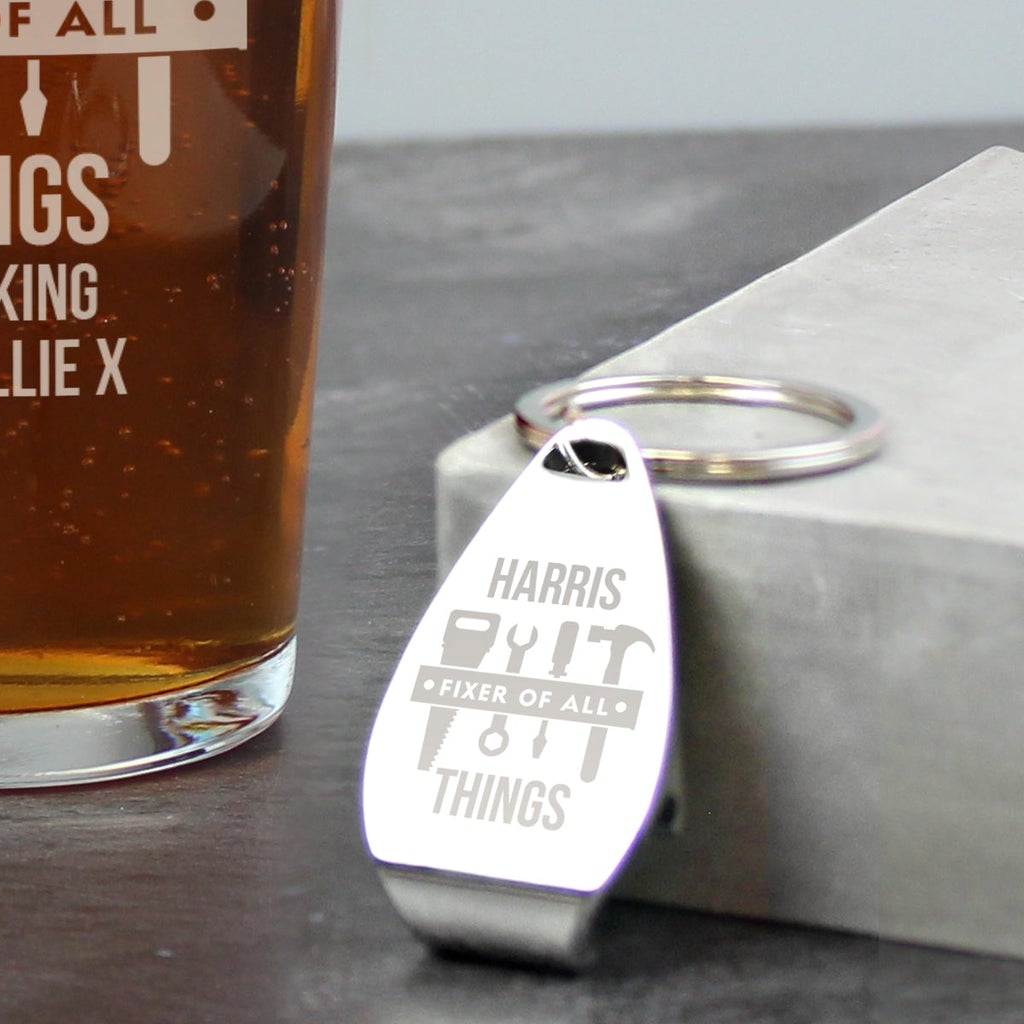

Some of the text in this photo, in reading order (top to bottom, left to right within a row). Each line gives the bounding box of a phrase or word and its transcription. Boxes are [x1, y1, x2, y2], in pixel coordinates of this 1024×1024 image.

[56, 0, 157, 36] ALL
[96, 338, 128, 395] X
[487, 557, 626, 610] HARRIS
[438, 679, 609, 717] FIXER OF ALL
[432, 767, 571, 831] THINGS
